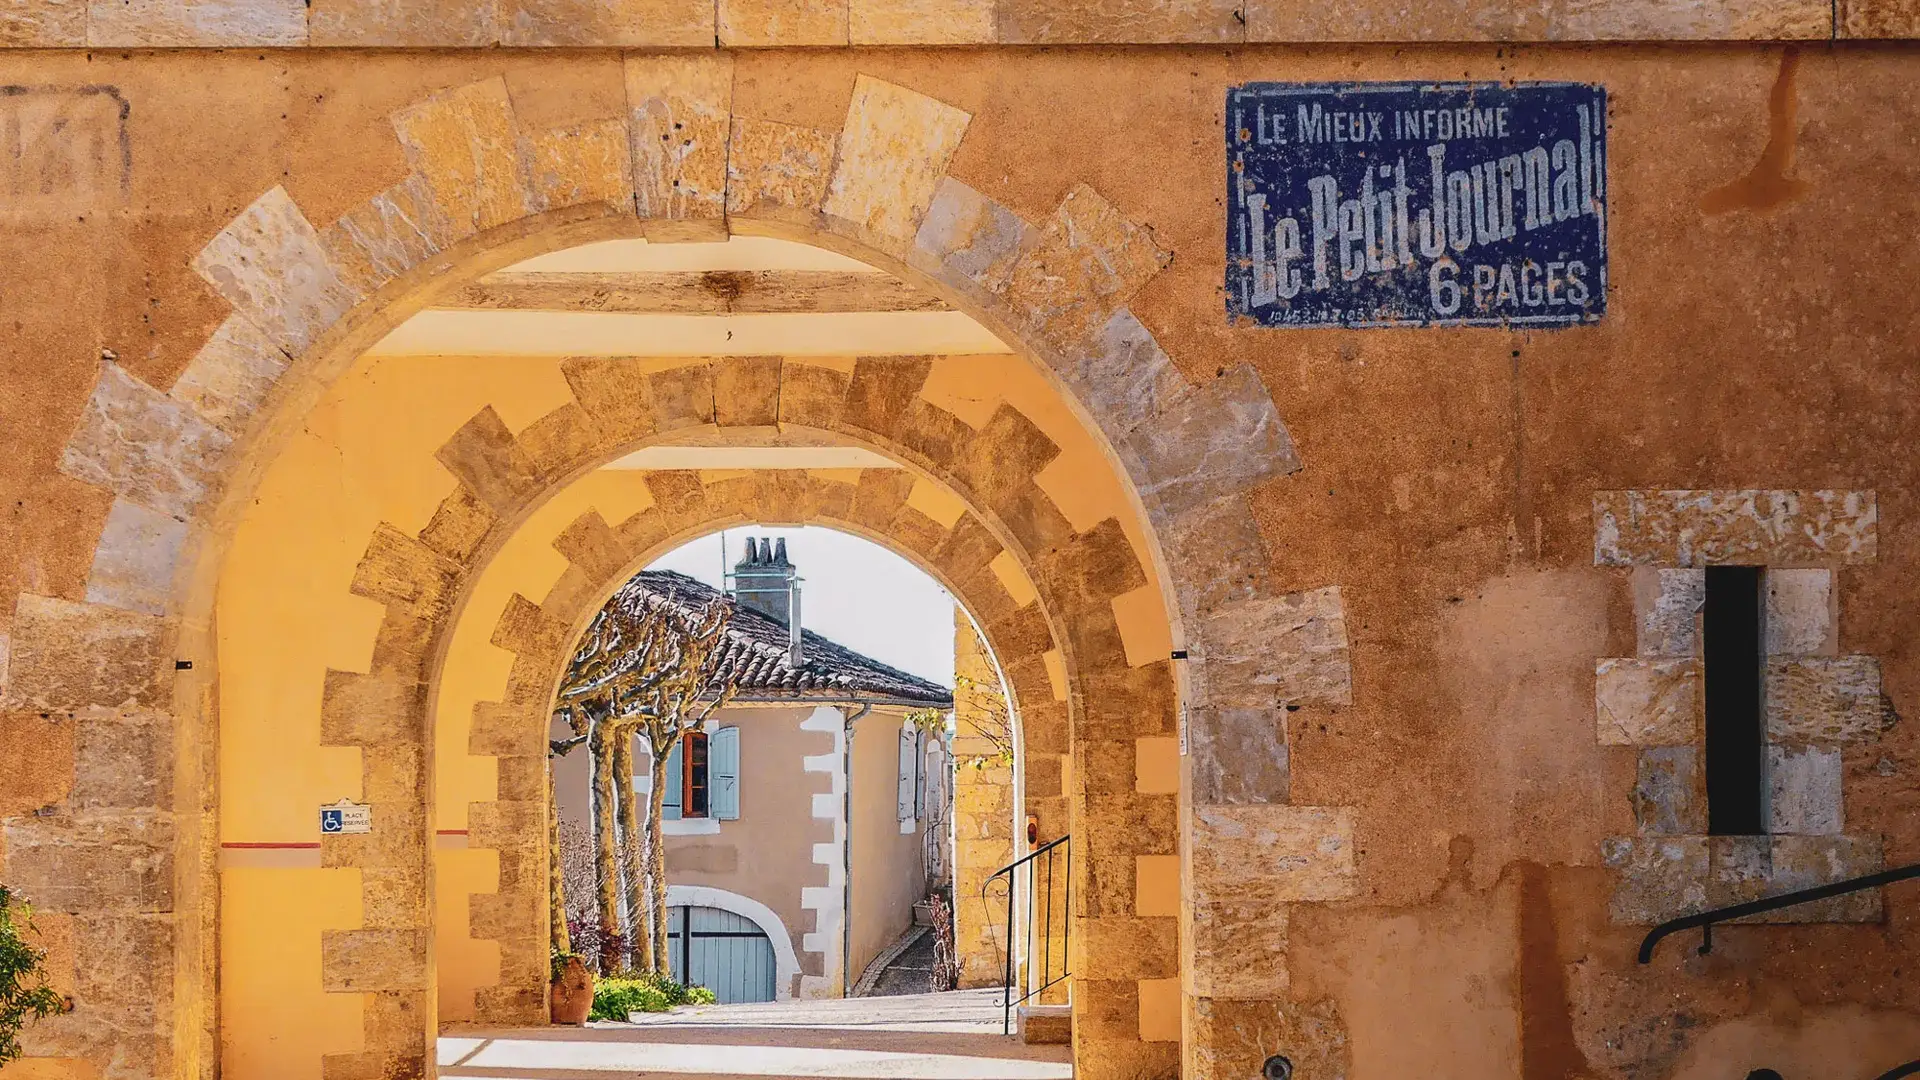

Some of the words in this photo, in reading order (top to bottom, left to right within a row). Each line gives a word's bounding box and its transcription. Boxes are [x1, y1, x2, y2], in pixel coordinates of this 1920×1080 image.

[1247, 193, 1302, 308] Le
[1308, 156, 1417, 291] Petit
[1419, 103, 1595, 258] Journal
[1429, 257, 1461, 315] 6
[1473, 261, 1590, 308] PAGES
